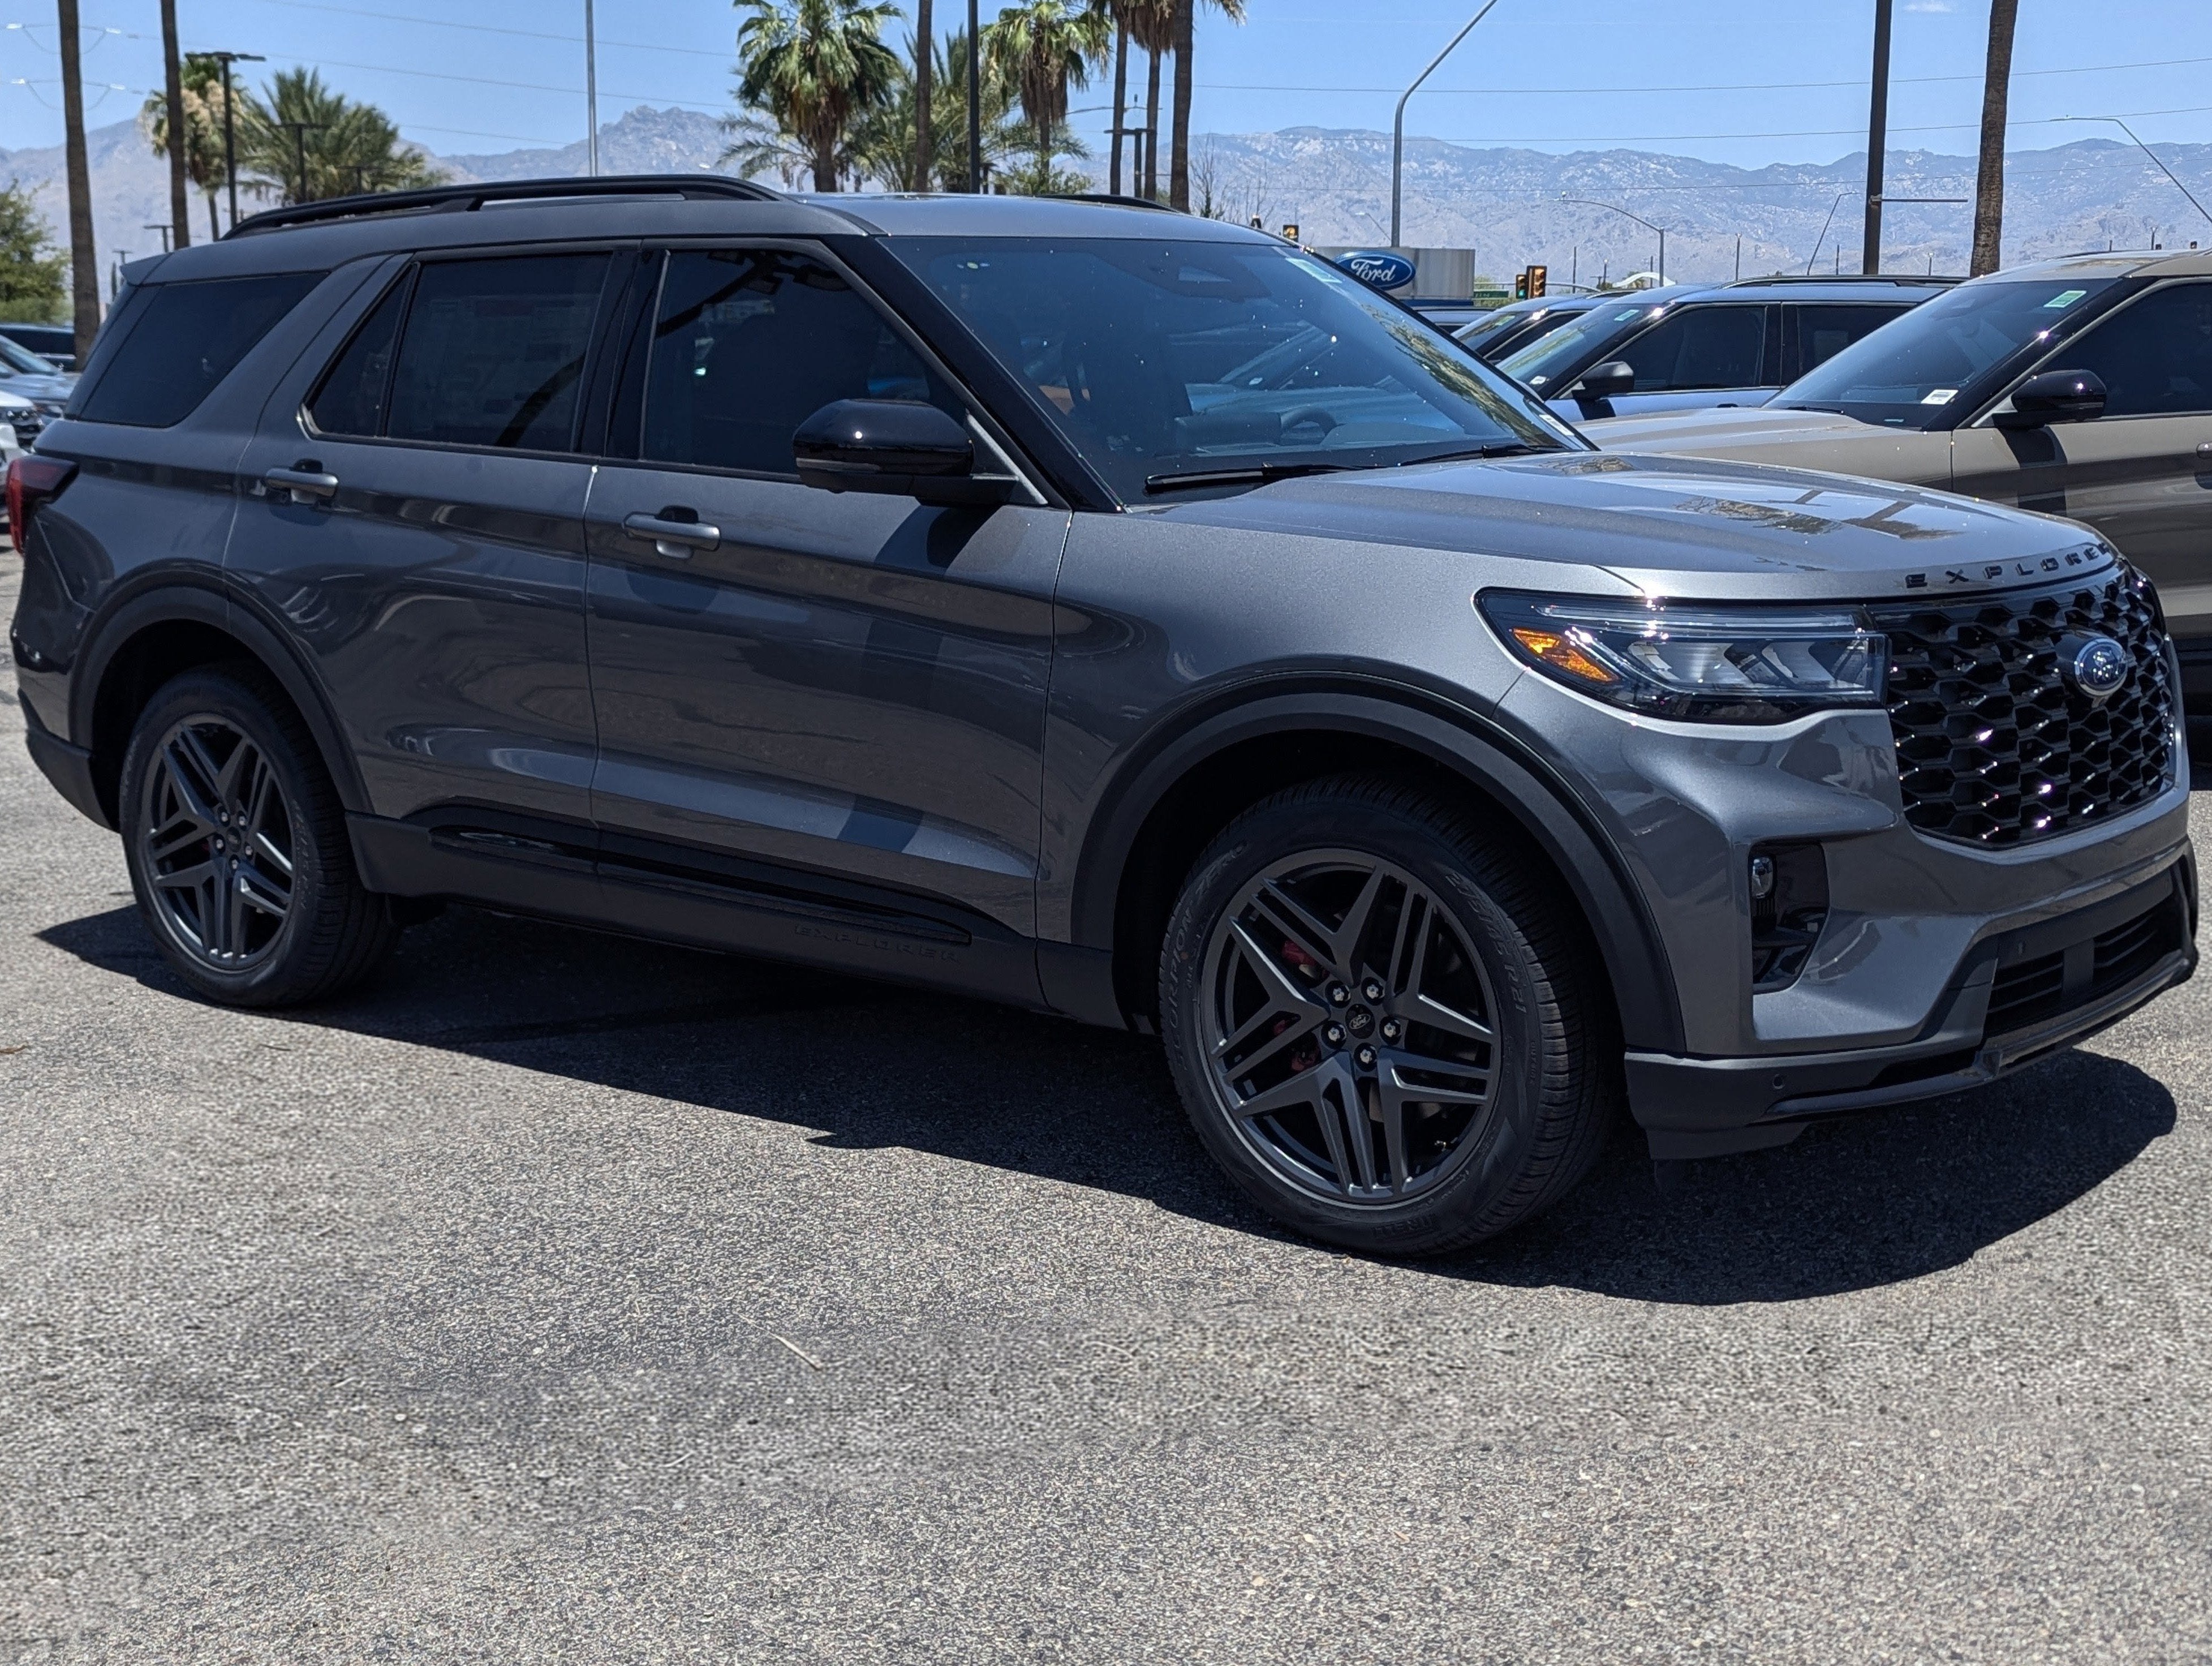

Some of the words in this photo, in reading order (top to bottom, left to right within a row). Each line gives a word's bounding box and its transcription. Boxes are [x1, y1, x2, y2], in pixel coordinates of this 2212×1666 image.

[1350, 258, 1397, 282] Ford
[1905, 542, 2110, 589] EXPLORER
[794, 924, 960, 963] EXPLORER
[1169, 900, 1193, 1071] SCORPION
